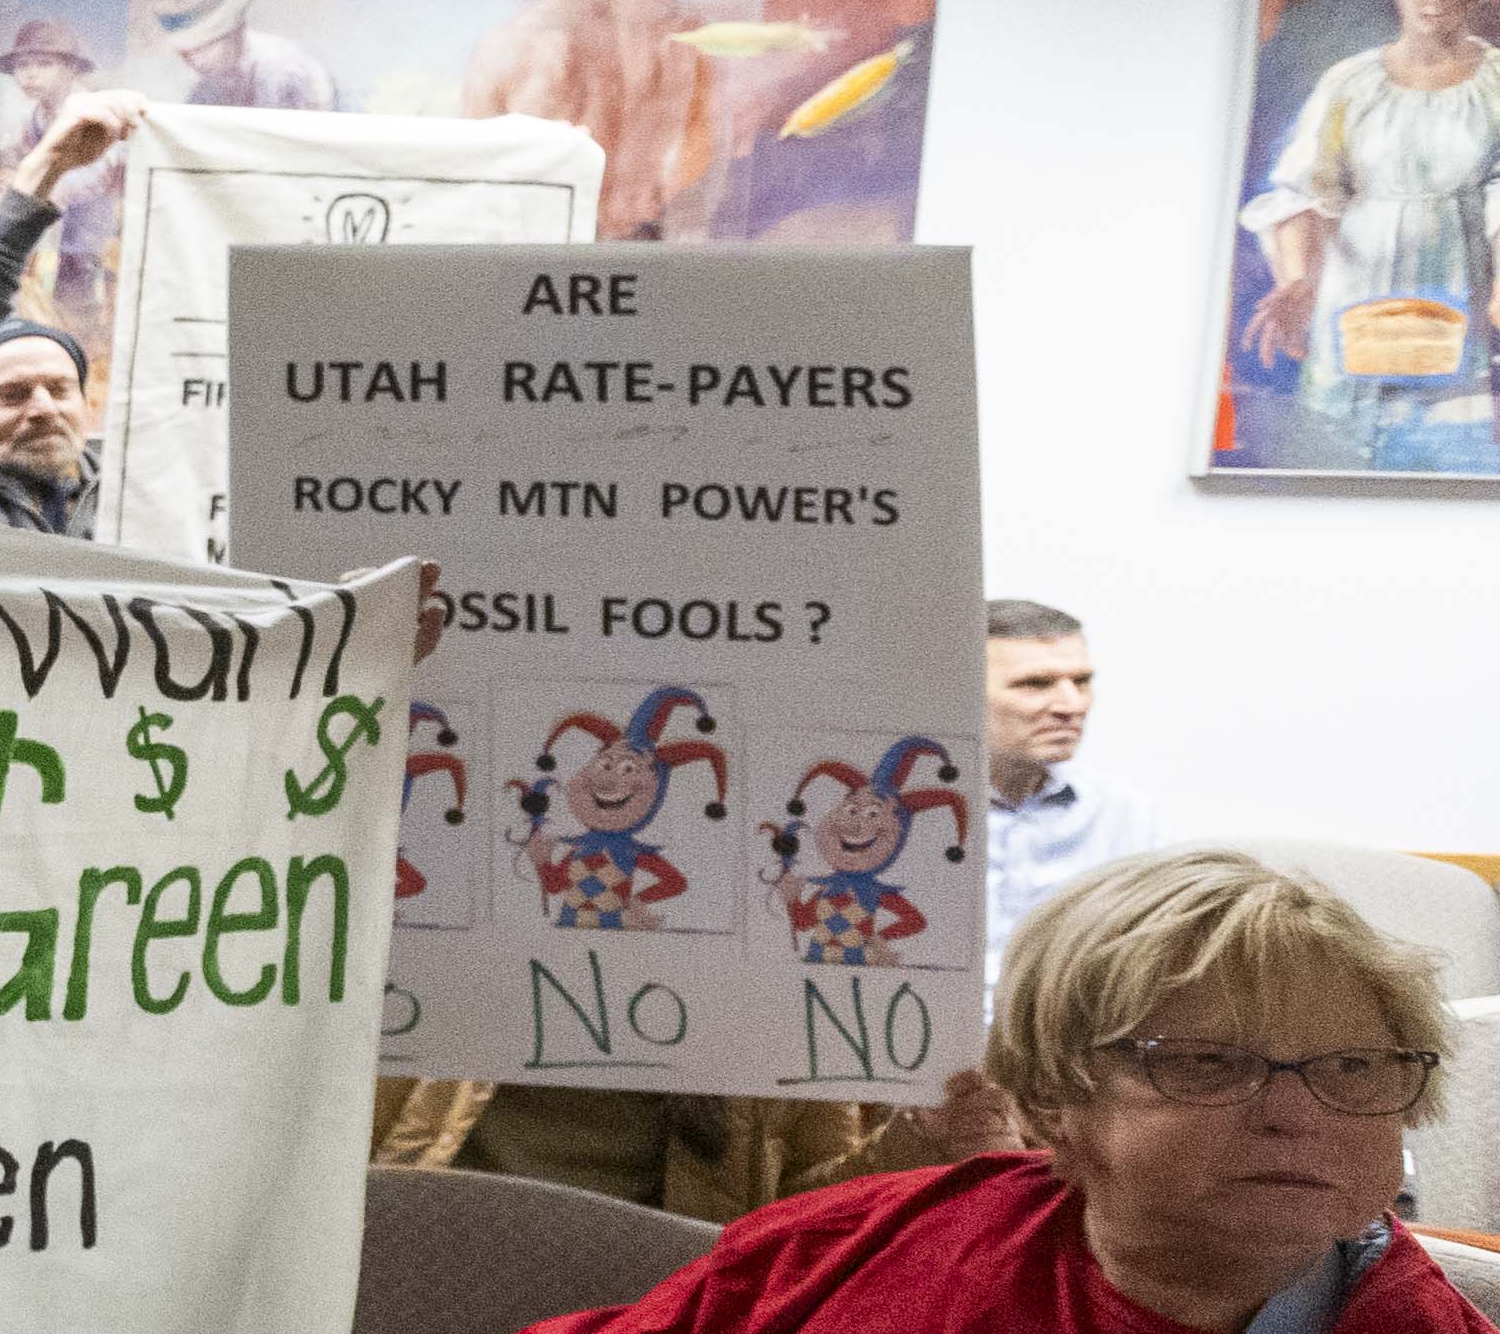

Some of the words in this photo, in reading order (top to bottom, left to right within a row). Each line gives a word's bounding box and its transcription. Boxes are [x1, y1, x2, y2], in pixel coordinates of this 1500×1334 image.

[522, 274, 637, 317] ARE
[286, 361, 448, 404] UTAH
[502, 361, 913, 410] RATE-PAYERS
[293, 475, 462, 515] ROCKY
[498, 480, 618, 519] MTN
[660, 482, 900, 527] POWER'S
[430, 590, 569, 635] SSIL
[600, 597, 784, 644] FOOLS
